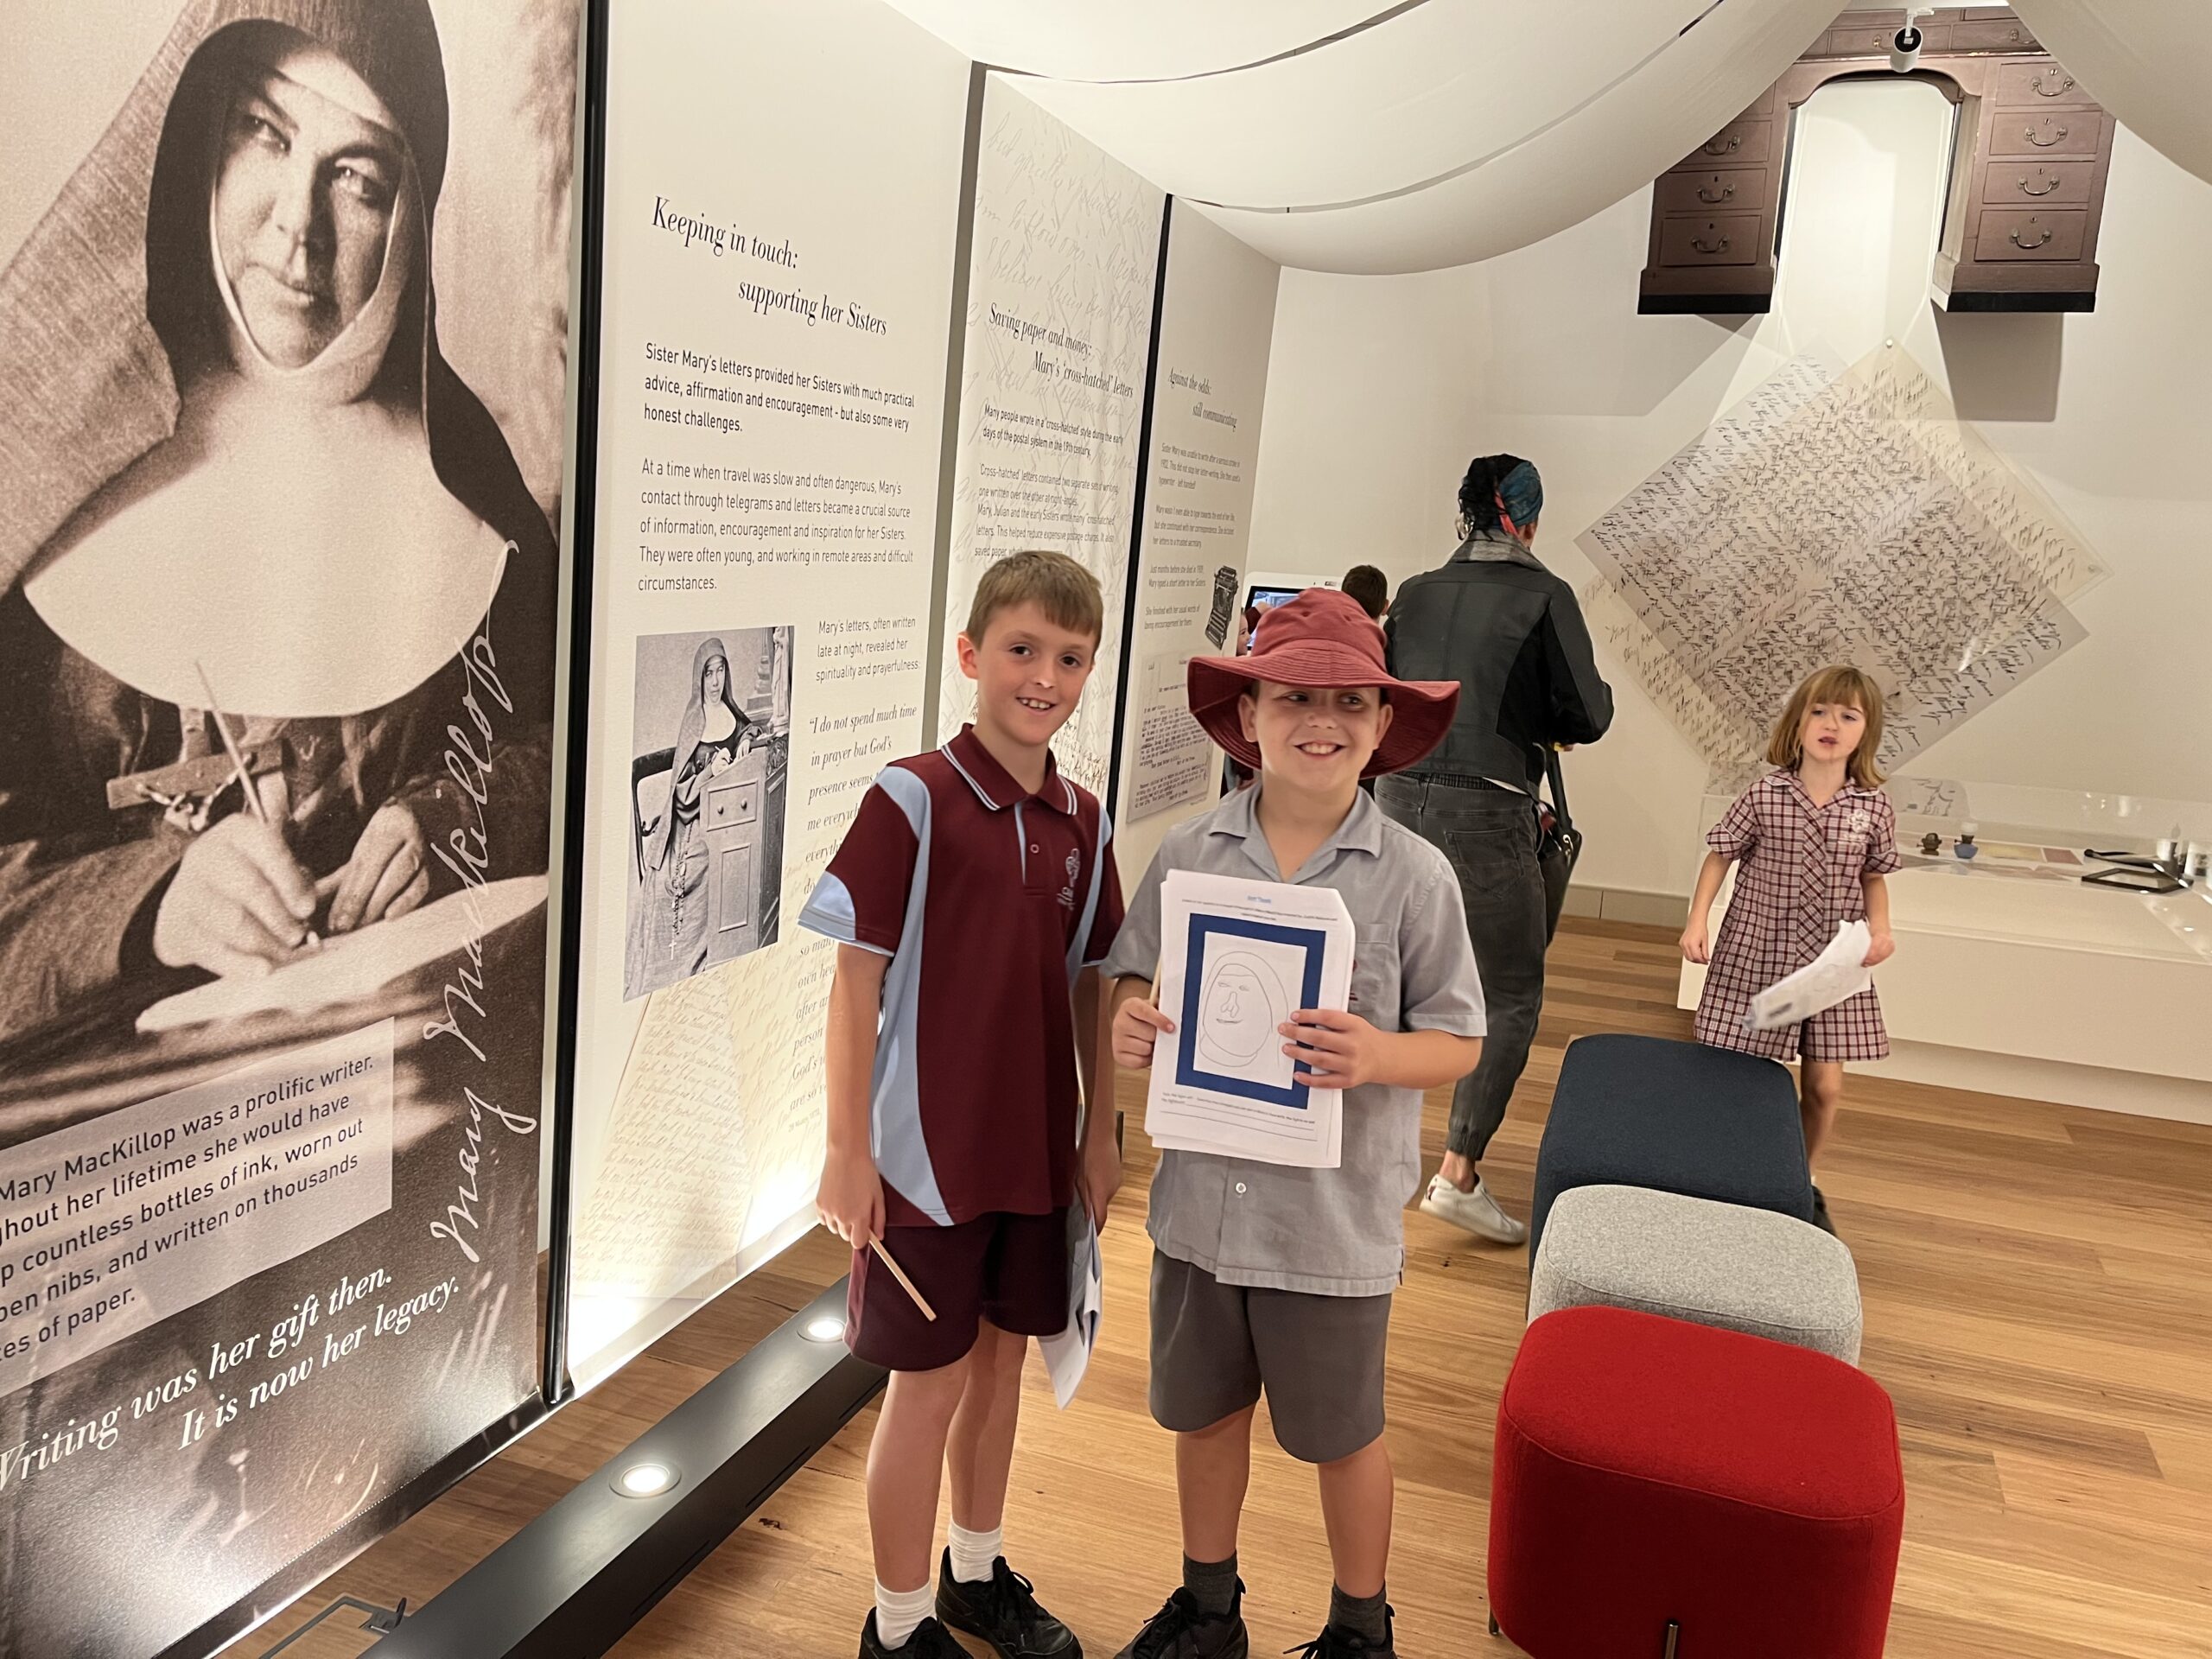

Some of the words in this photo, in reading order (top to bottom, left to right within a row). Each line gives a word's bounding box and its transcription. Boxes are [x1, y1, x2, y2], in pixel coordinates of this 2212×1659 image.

[652, 196, 725, 257] Keeping
[730, 223, 745, 252] in
[752, 236, 797, 268] touch:
[738, 282, 817, 326] supporting
[821, 294, 843, 322] her
[847, 302, 886, 334] Sisters
[988, 302, 1021, 339] Saving
[1021, 321, 1046, 345] paper
[1048, 327, 1065, 349] and
[1065, 337, 1092, 361] money:
[645, 342, 678, 364] Sister
[682, 349, 716, 373] Mary's
[720, 356, 751, 377] letters
[754, 367, 793, 385] provided
[796, 372, 810, 387] her
[812, 375, 841, 393] Sisters
[842, 382, 859, 397] with
[862, 388, 881, 400] much
[884, 392, 913, 407] practical
[1033, 350, 1060, 382] Mary's
[1113, 376, 1134, 399] letters
[645, 374, 682, 397] advice,
[686, 381, 742, 404] affirmation
[746, 392, 762, 406] and
[765, 397, 832, 417] encouragement
[841, 406, 853, 420] but
[855, 409, 870, 423] also
[873, 415, 892, 426] some
[894, 418, 908, 432] very
[645, 402, 680, 423] honest
[684, 410, 741, 433] challenges.
[984, 404, 999, 421] Many
[1000, 410, 1018, 423] people
[642, 457, 653, 474] At
[657, 463, 662, 474] a
[666, 460, 690, 477] time
[693, 463, 720, 480] when
[723, 467, 750, 482] travel
[753, 472, 770, 484] was
[772, 470, 793, 485] slow
[795, 473, 810, 486] and
[813, 474, 832, 487] often
[835, 476, 876, 494] dangerous,
[879, 480, 900, 496] Mary's
[641, 490, 680, 505] contact
[684, 490, 722, 512] through
[726, 493, 772, 513] telegrams
[775, 497, 791, 511] and
[793, 497, 820, 512] letters
[823, 499, 853, 514] became
[855, 505, 859, 514] a
[861, 504, 885, 516] crucial
[887, 507, 910, 517] source
[640, 517, 651, 532] of
[653, 517, 716, 537] information,
[720, 524, 791, 539] encouragement
[793, 523, 809, 537] and
[811, 523, 852, 541] inspiration
[855, 524, 864, 538] for
[867, 526, 879, 538] her
[880, 526, 905, 539] Sisters.
[639, 545, 664, 566] They
[667, 550, 693, 562] were
[696, 547, 721, 562] often
[724, 551, 753, 566] young,
[757, 547, 772, 562] and
[776, 548, 810, 565] working
[812, 549, 819, 561] in
[822, 550, 849, 562] remote
[850, 552, 871, 562] areas
[873, 550, 886, 562] and
[887, 550, 912, 562] difficult
[638, 575, 716, 590] circumstances.
[818, 620, 843, 636] Mary's
[845, 619, 870, 632] letters,
[873, 617, 890, 629] often
[893, 616, 915, 627] written
[817, 644, 831, 657] late
[833, 644, 841, 656] at
[843, 641, 863, 658] night,
[866, 638, 894, 652] revealed
[896, 638, 907, 649] her
[816, 665, 855, 683] spirituality
[857, 662, 870, 676] and
[819, 715, 830, 732] do
[833, 715, 848, 729] not
[849, 709, 874, 731] spend
[876, 705, 897, 721] much
[900, 704, 918, 718] time
[811, 751, 819, 766] in
[821, 748, 851, 770] prayer
[854, 741, 867, 757] but
[869, 736, 891, 753] God's
[807, 782, 847, 805] presence
[849, 774, 872, 788] seems
[807, 817, 821, 831] me
[823, 802, 860, 827] everywh
[805, 837, 842, 863] everythi
[800, 944, 809, 956] so
[796, 998, 817, 1023] after
[792, 1027, 823, 1057] person
[792, 1053, 817, 1080] God's
[0, 1170, 56, 1201] Mary
[65, 1127, 175, 1181] MacKillop
[182, 1113, 223, 1137] was
[229, 1103, 239, 1119] a
[245, 1077, 315, 1117] prolific
[320, 1055, 373, 1087] writer.
[0, 1202, 59, 1247] hout
[67, 1185, 105, 1216] her
[112, 1154, 196, 1197] lifetime
[203, 1137, 238, 1163] she
[243, 1108, 302, 1145] would
[309, 1095, 349, 1122] have
[430, 1086, 537, 1263] Mary
[22, 1214, 133, 1271] countless
[140, 1181, 213, 1224] bottles
[219, 1165, 238, 1191] of
[243, 1154, 278, 1180] ink,
[284, 1135, 332, 1163] worn
[338, 1118, 363, 1142] out
[48, 1268, 101, 1301] nibs,
[108, 1239, 147, 1273] and
[155, 1210, 228, 1253] written
[235, 1198, 257, 1218] on
[263, 1154, 358, 1205] thousands
[39, 1314, 60, 1343] of
[67, 1287, 135, 1336] paper.
[130, 1366, 197, 1420] was
[209, 1332, 261, 1381] her
[267, 1295, 321, 1358] gift
[327, 1268, 392, 1316] then.
[177, 1407, 206, 1450] It
[215, 1392, 238, 1427] is
[249, 1355, 314, 1409] now
[321, 1324, 368, 1369] her
[373, 1274, 460, 1342] legacy.
